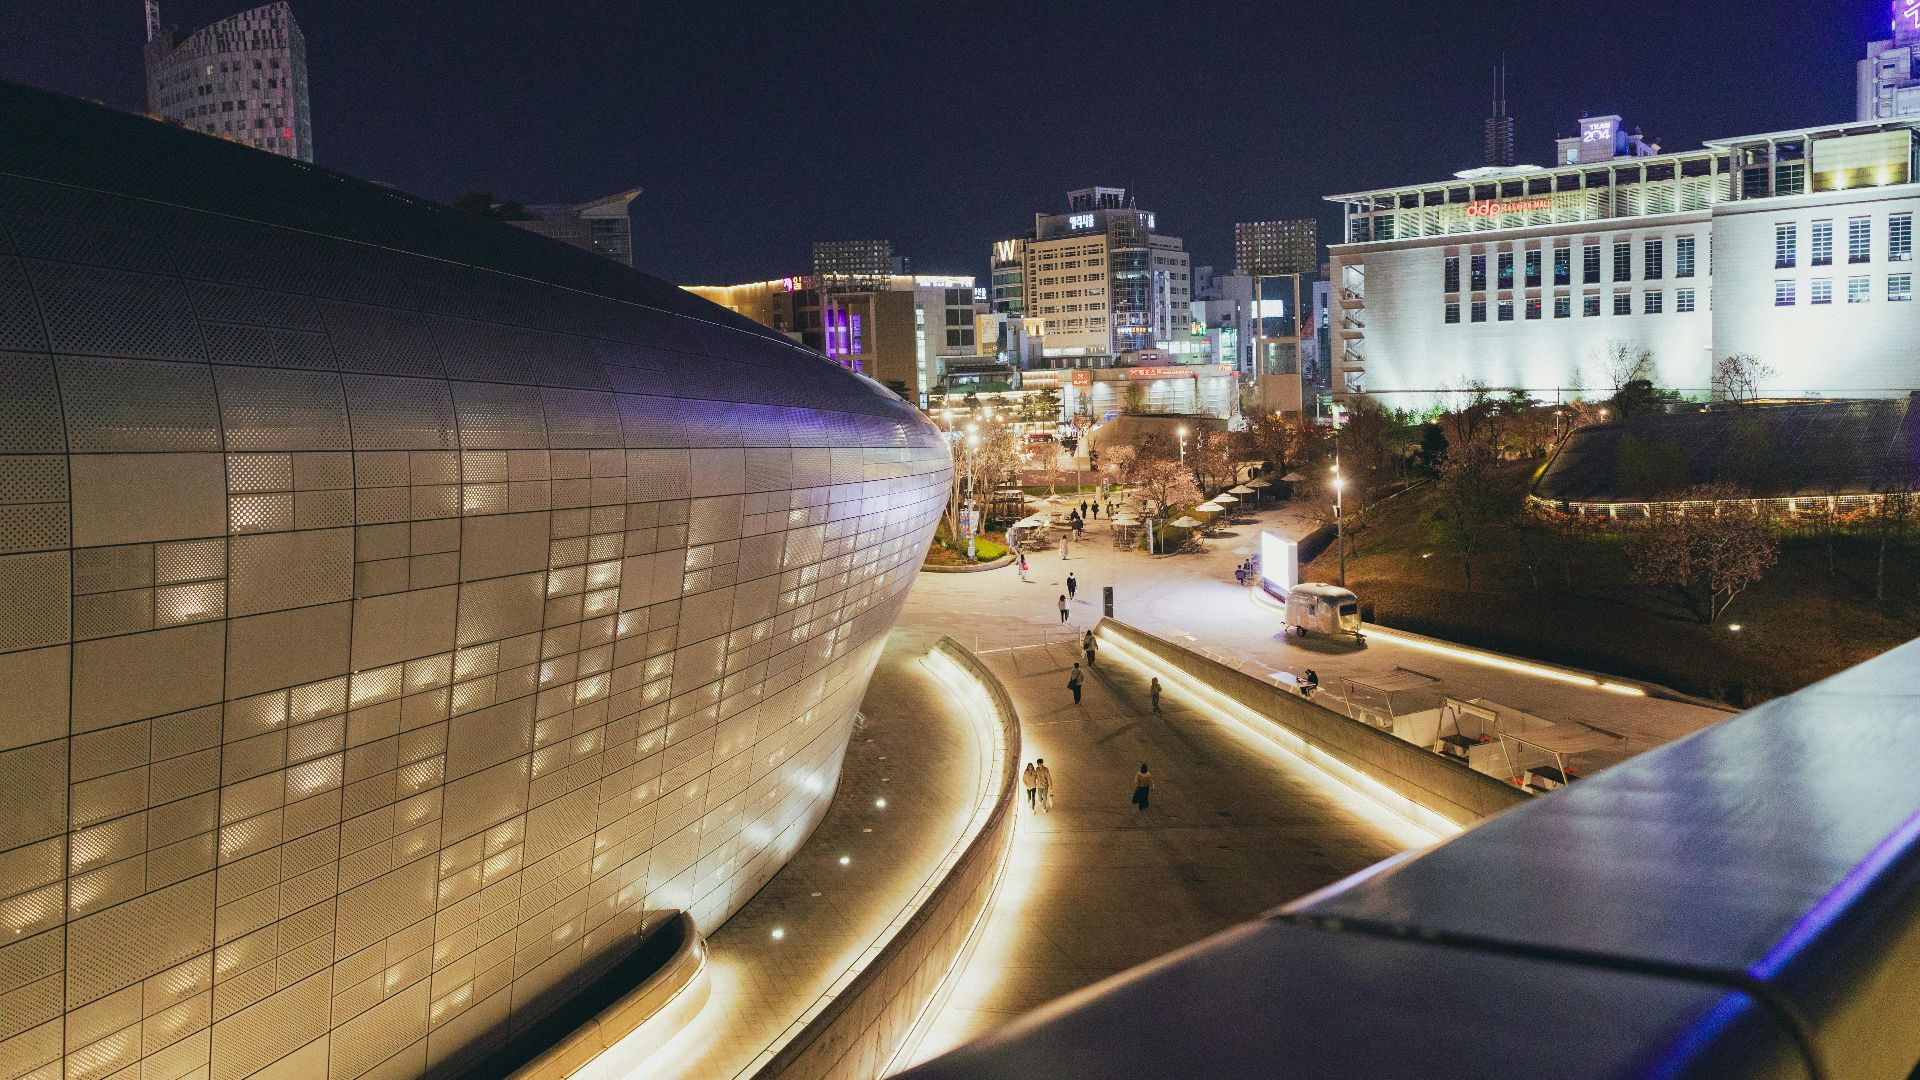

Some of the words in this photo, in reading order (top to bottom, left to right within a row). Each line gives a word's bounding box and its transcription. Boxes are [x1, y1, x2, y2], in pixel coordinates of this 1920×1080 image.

[1583, 129, 1611, 142] 204
[1466, 199, 1502, 221] ddp
[1504, 201, 1532, 212] FASHION
[1534, 199, 1552, 210] MALL
[998, 239, 1016, 262] W
